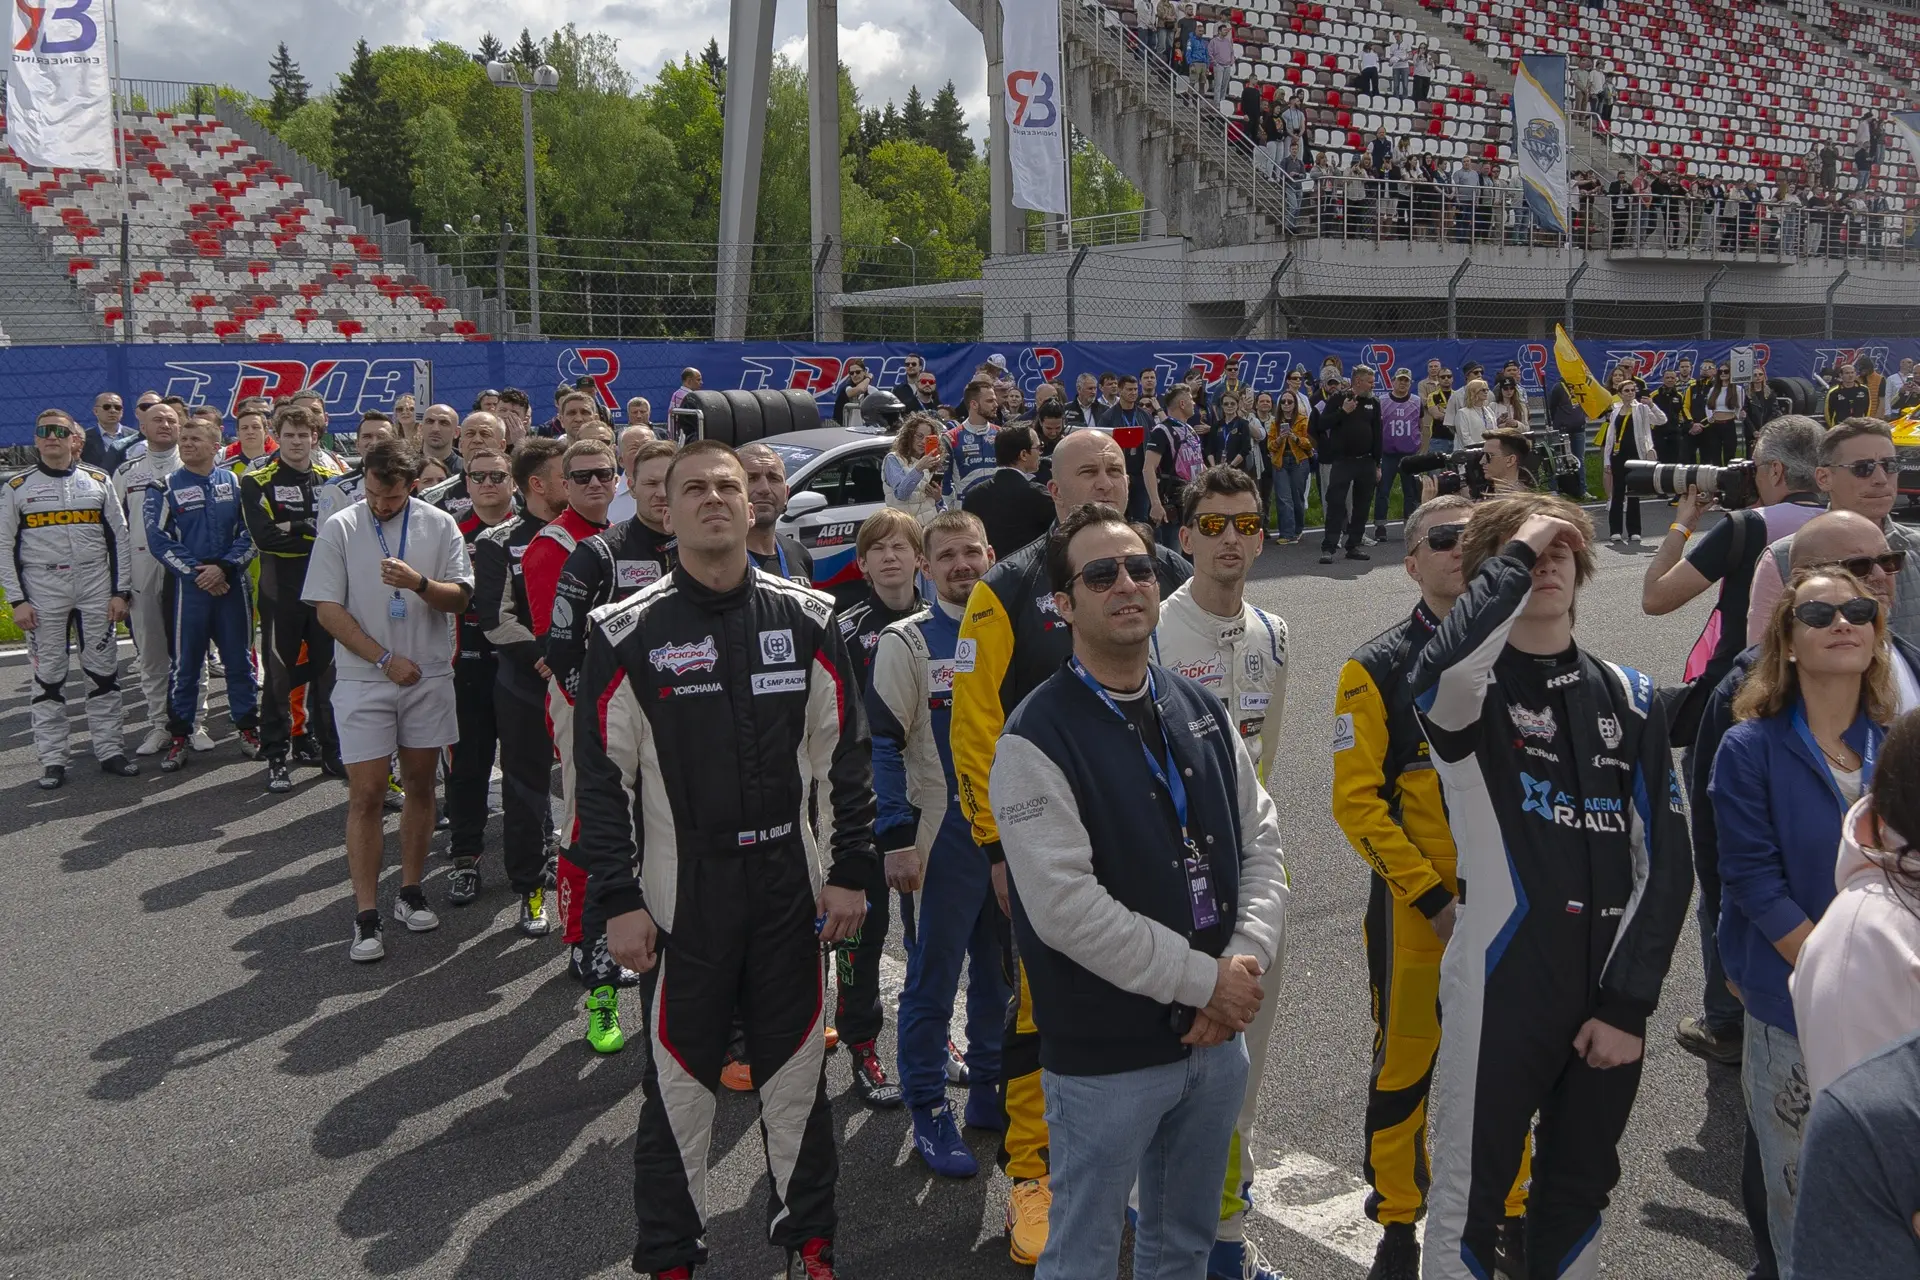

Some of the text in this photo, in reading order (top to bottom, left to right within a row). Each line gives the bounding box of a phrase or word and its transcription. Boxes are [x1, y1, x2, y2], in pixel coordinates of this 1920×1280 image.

[1738, 359, 1746, 373] 8
[1389, 419, 1412, 437] 131
[818, 522, 855, 538] АВТО
[804, 600, 827, 617] OMP
[972, 607, 994, 623] freem
[608, 614, 632, 633] OMP
[1220, 626, 1245, 639] HRX
[667, 651, 705, 660] РСКГ.РФ
[766, 678, 784, 687] SMP
[1546, 670, 1581, 689] HRX
[673, 682, 723, 696] YOKOHAMA
[1343, 683, 1369, 701] freem
[1006, 796, 1048, 815] SKOLKOVO
[760, 821, 793, 841] N. ORLOV
[1191, 876, 1207, 892] ВИП
